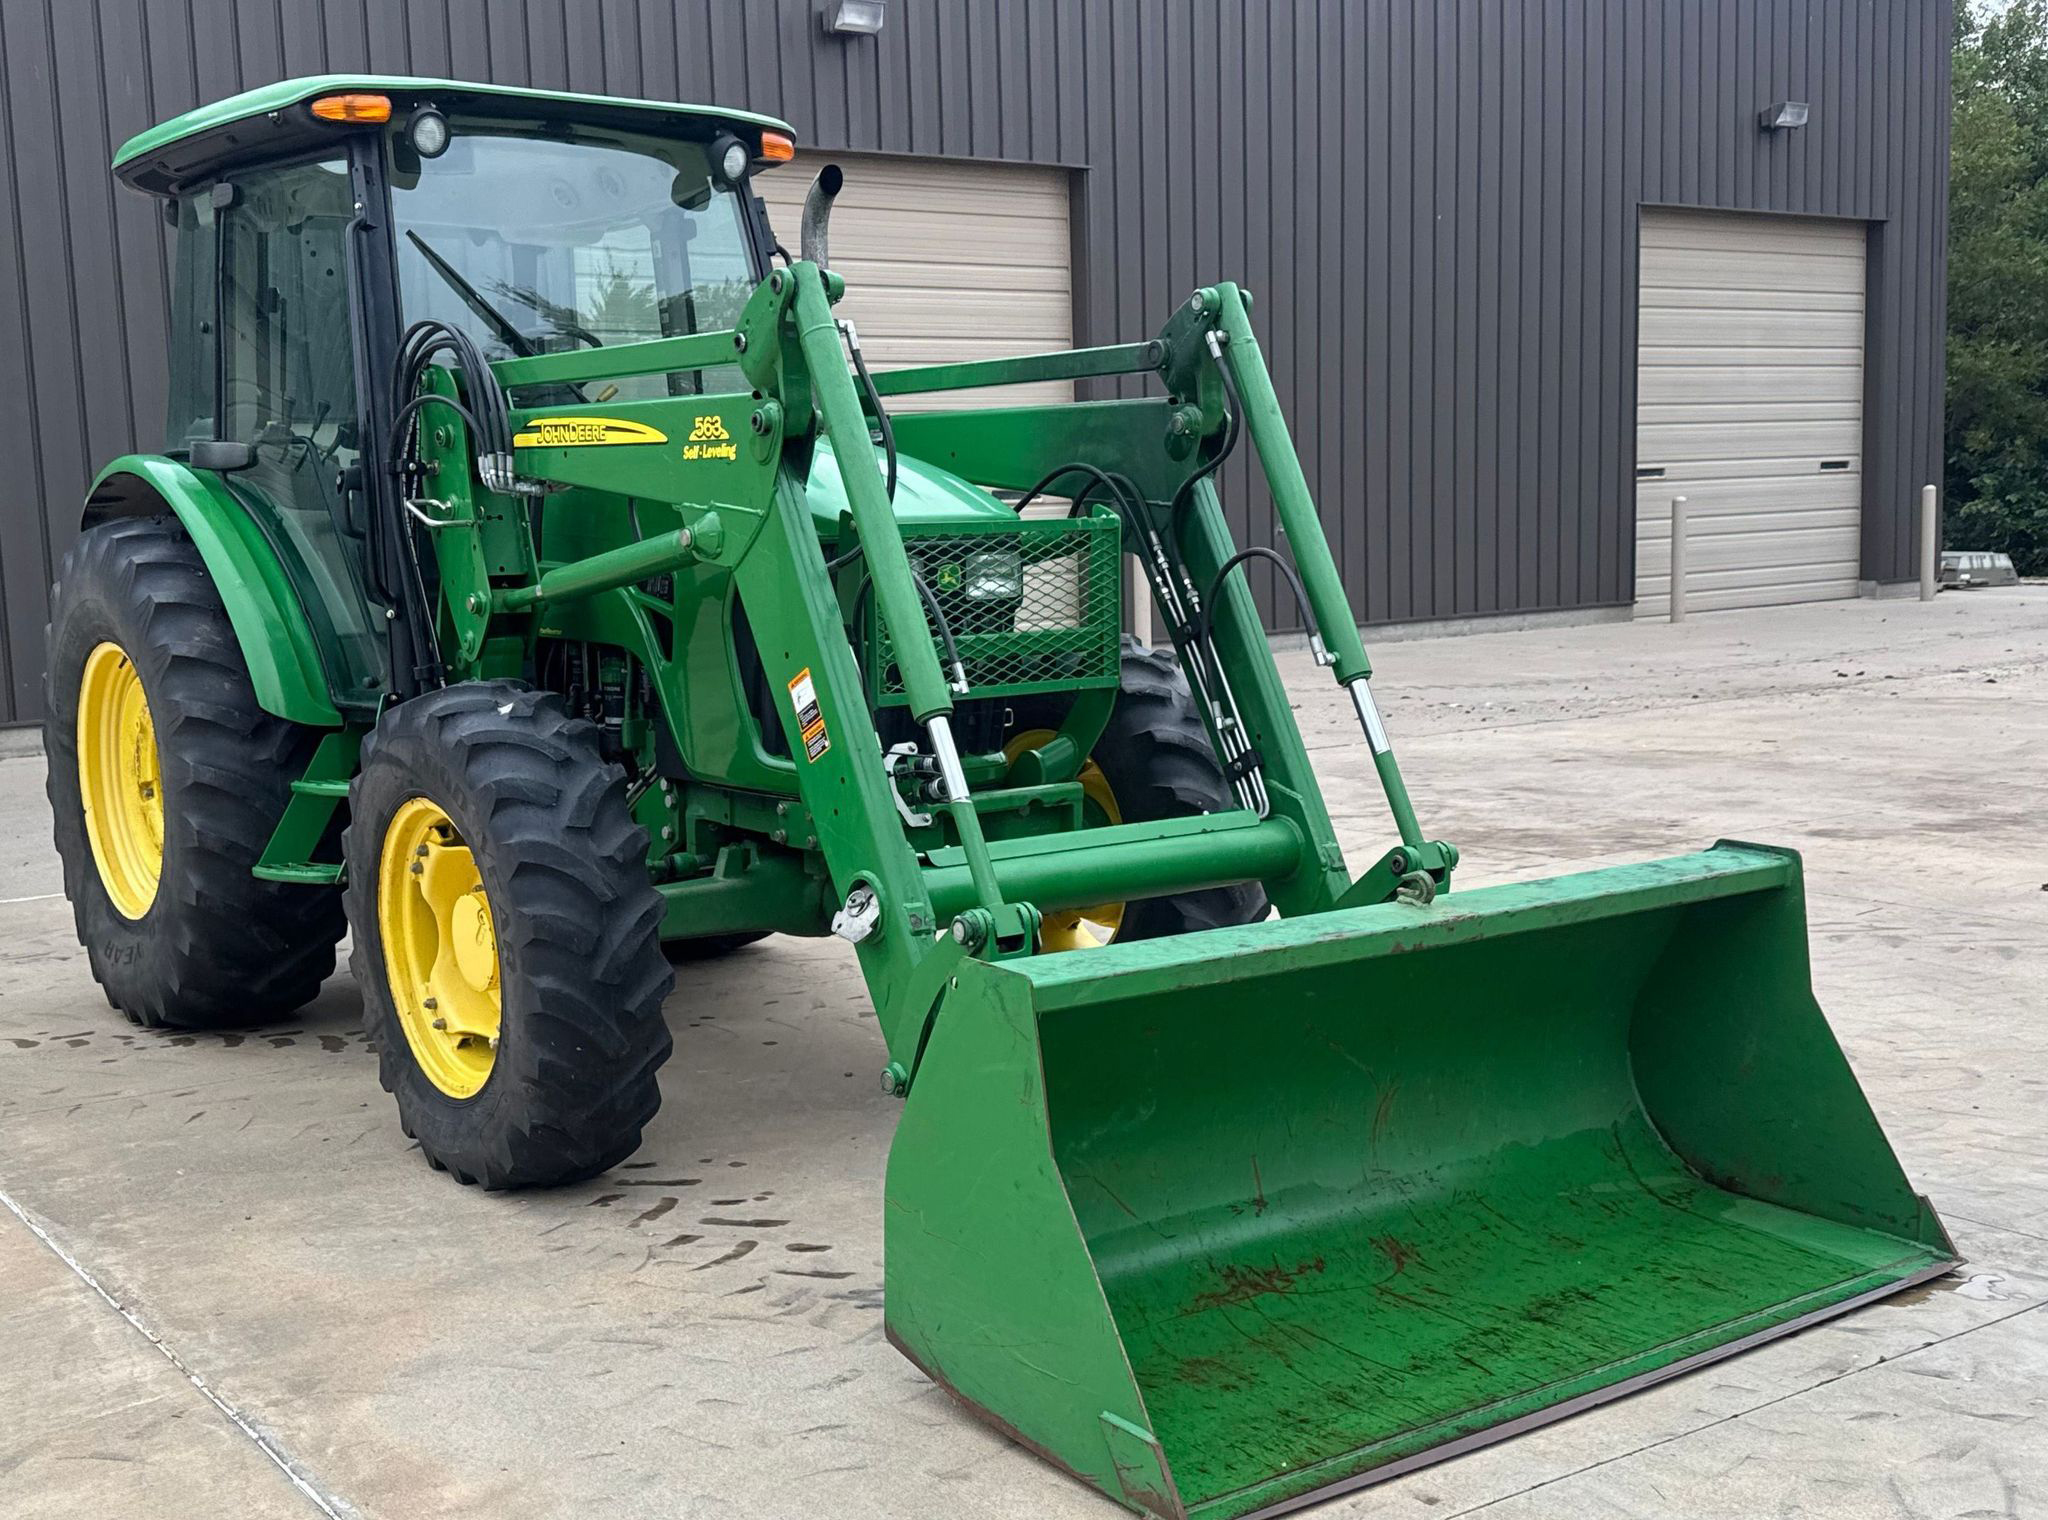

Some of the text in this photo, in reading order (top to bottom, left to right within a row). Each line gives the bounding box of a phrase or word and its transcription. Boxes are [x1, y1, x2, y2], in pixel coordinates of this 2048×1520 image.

[537, 421, 607, 443] JOHN DEERE
[694, 415, 723, 438] 563
